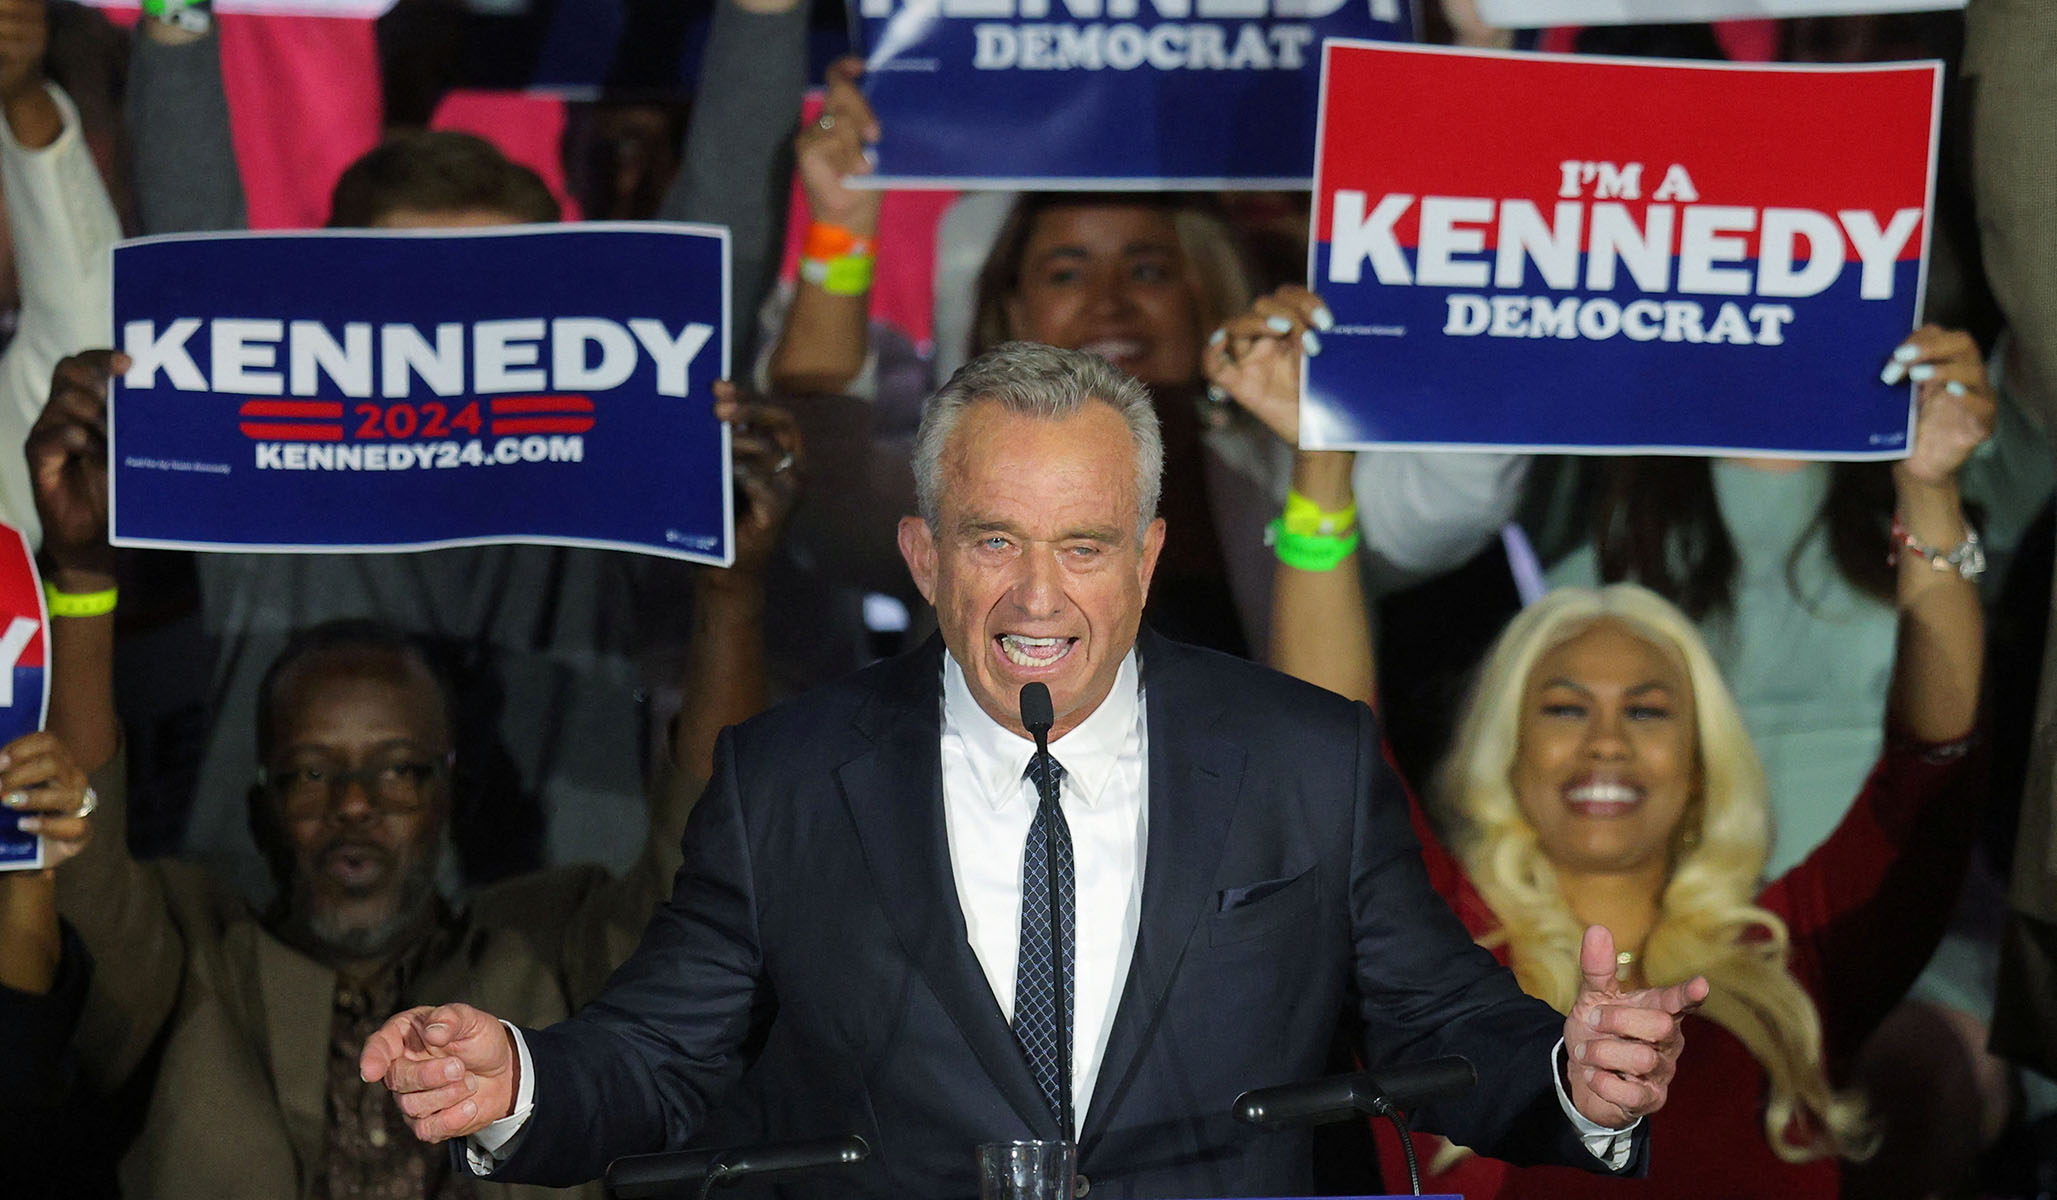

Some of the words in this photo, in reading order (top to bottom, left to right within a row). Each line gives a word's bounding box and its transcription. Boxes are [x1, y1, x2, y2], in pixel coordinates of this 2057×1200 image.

[973, 23, 1313, 71] DEMOCRAT
[1558, 160, 1643, 200] I'M
[1653, 163, 1698, 202] A
[1328, 190, 1923, 300] KENNEDY
[1442, 293, 1794, 346] DEMOCRAT
[124, 317, 714, 398] KENNEDY
[354, 401, 483, 439] 2024
[255, 436, 583, 471] KENNEDY24.COM
